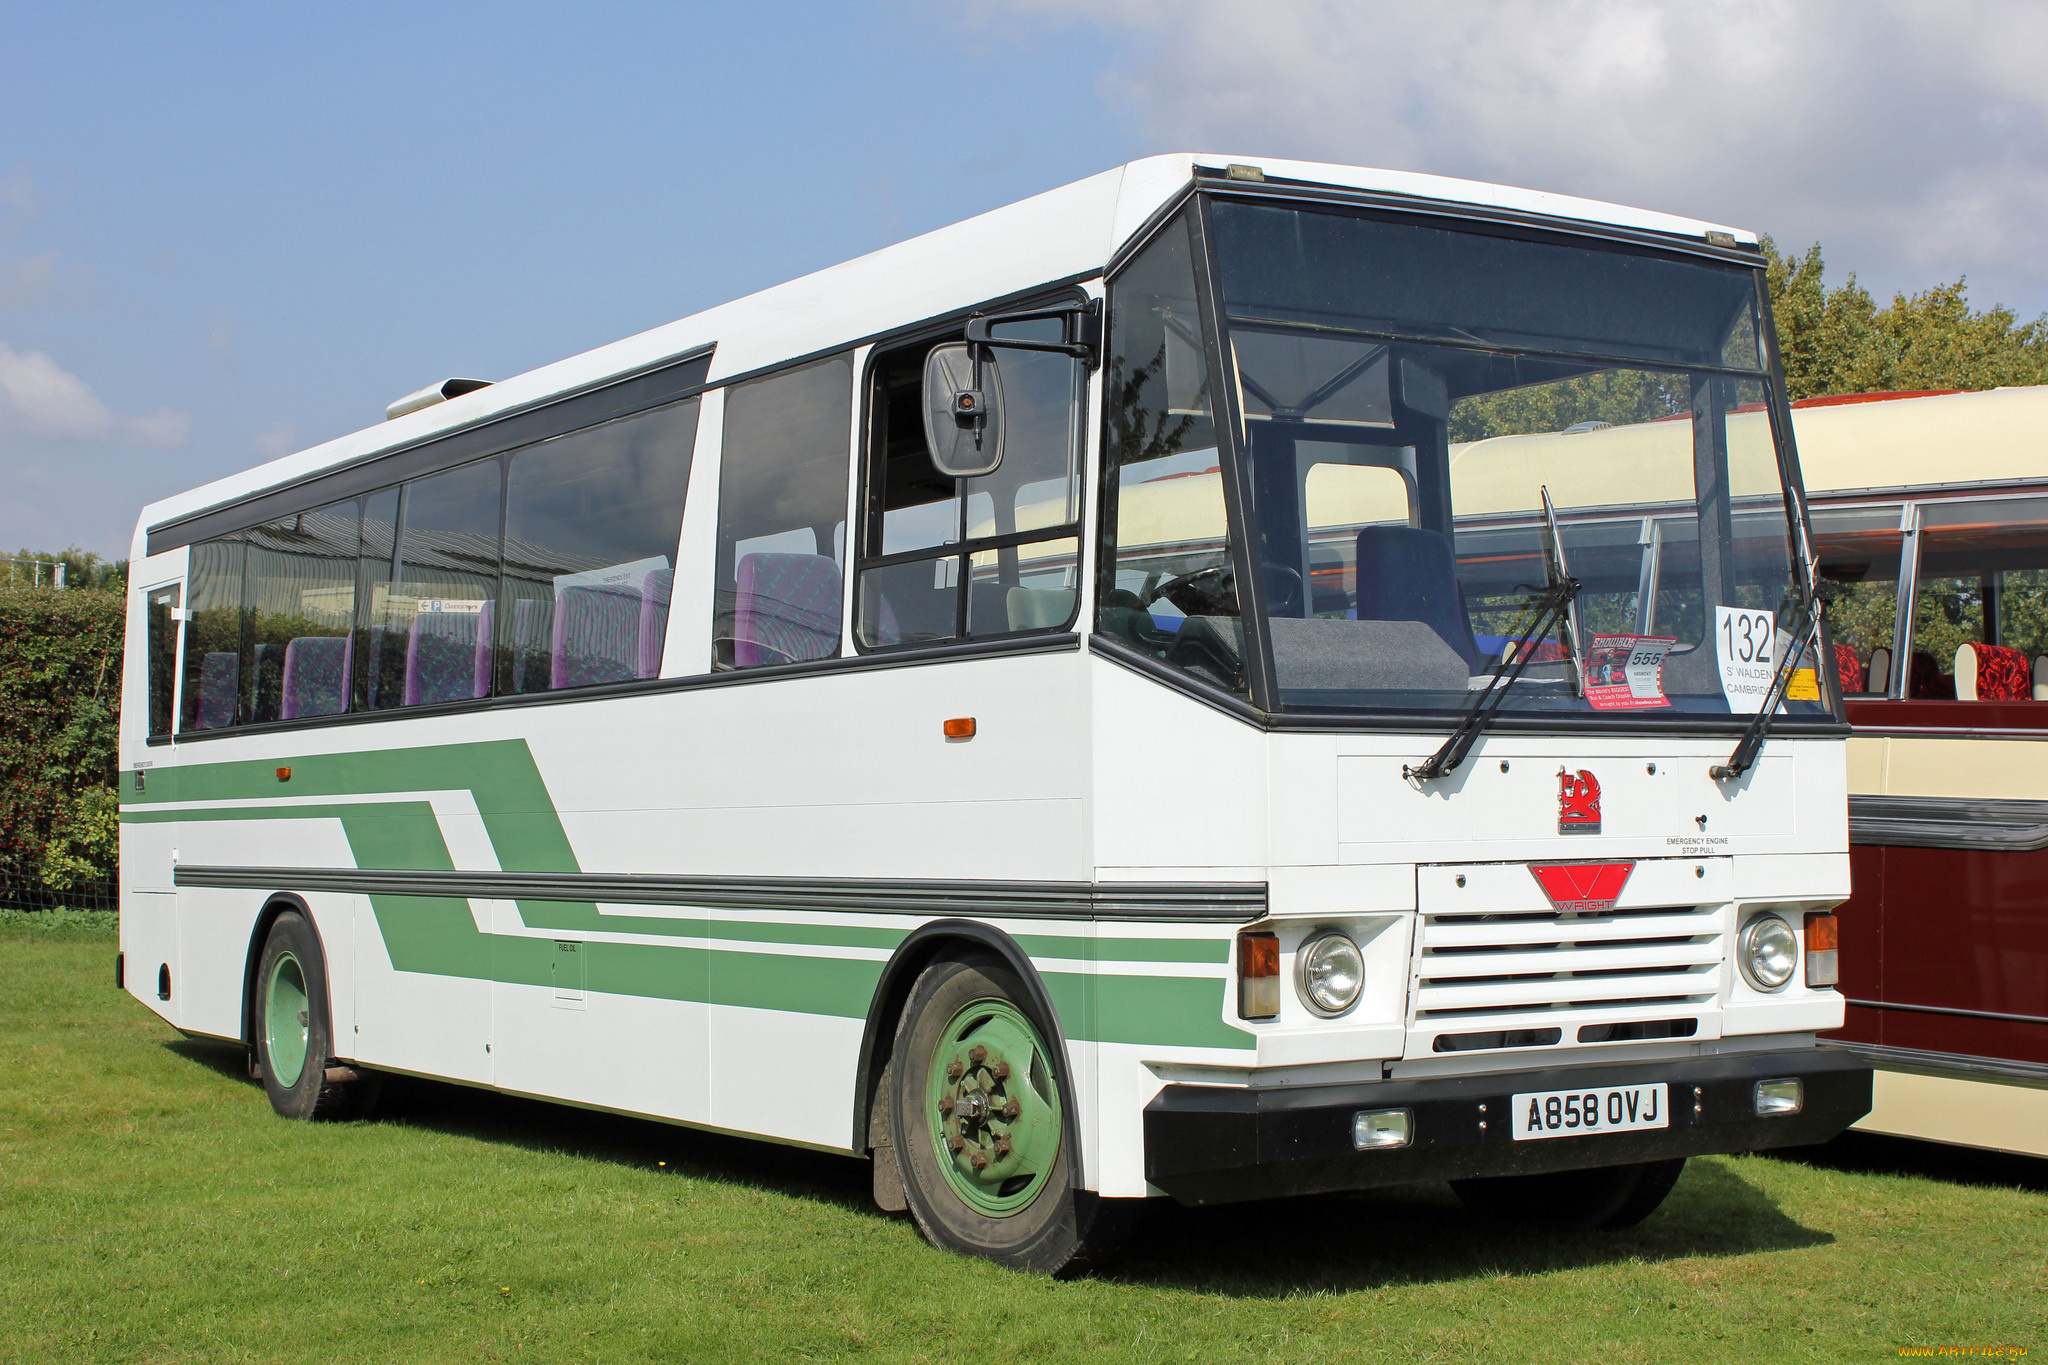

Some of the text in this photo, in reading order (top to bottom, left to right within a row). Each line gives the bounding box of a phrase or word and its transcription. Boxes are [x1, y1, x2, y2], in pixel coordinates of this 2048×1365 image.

[1592, 637, 1637, 648] SHOWBUS
[1723, 613, 1770, 663] 132
[1632, 652, 1662, 665] 555
[1735, 667, 1773, 680] WALDEN
[1666, 837, 1729, 845] EMERGENCY ENGINE
[1699, 846, 1715, 854] PULL
[1557, 900, 1615, 911] WRIGHT
[559, 944, 569, 952] FUEL
[1528, 1088, 1658, 1131] A858 OVJ
